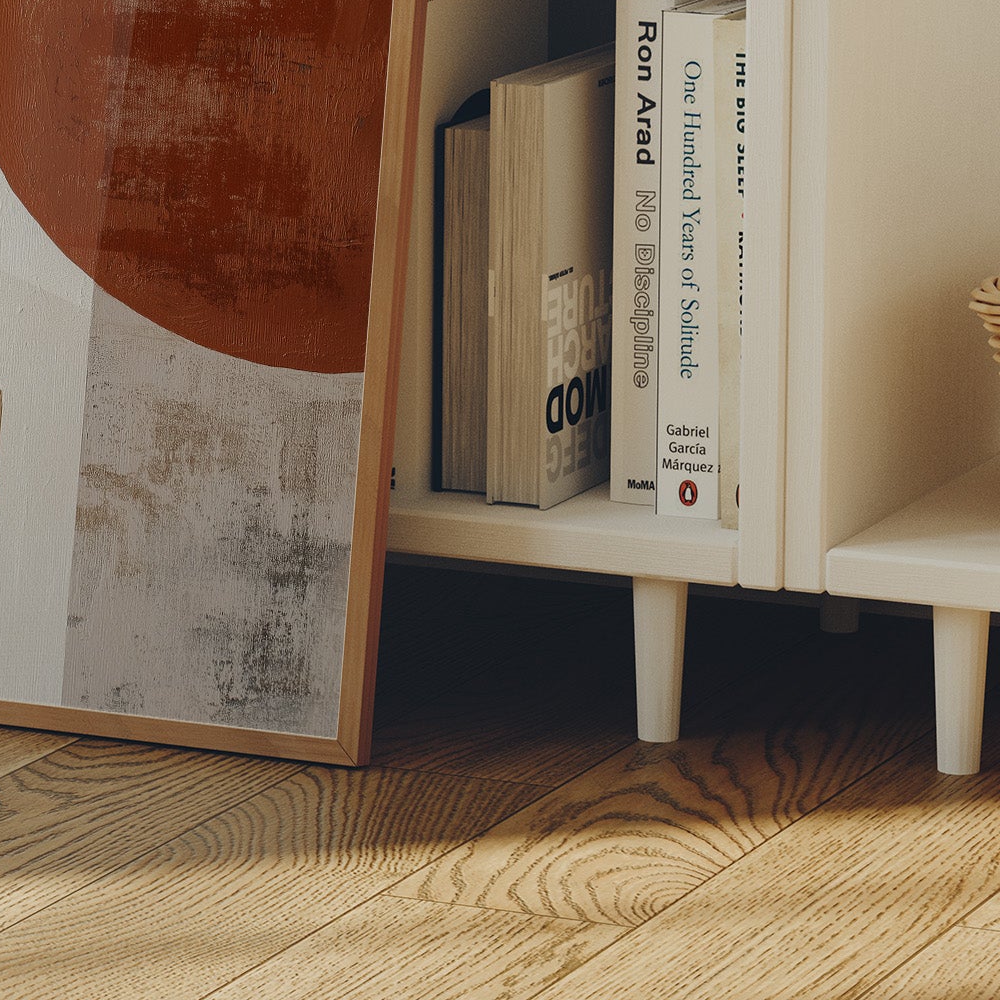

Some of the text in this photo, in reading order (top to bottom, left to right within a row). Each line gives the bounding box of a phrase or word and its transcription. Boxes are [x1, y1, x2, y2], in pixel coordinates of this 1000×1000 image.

[629, 21, 657, 389] Ron Arad No Discipline
[680, 60, 702, 379] One Hundred Years of Solitude
[546, 364, 608, 434] MOD
[666, 424, 710, 438] Gabriel
[668, 441, 706, 455] García
[662, 458, 713, 473] Márquez
[627, 479, 656, 490] MoMA
